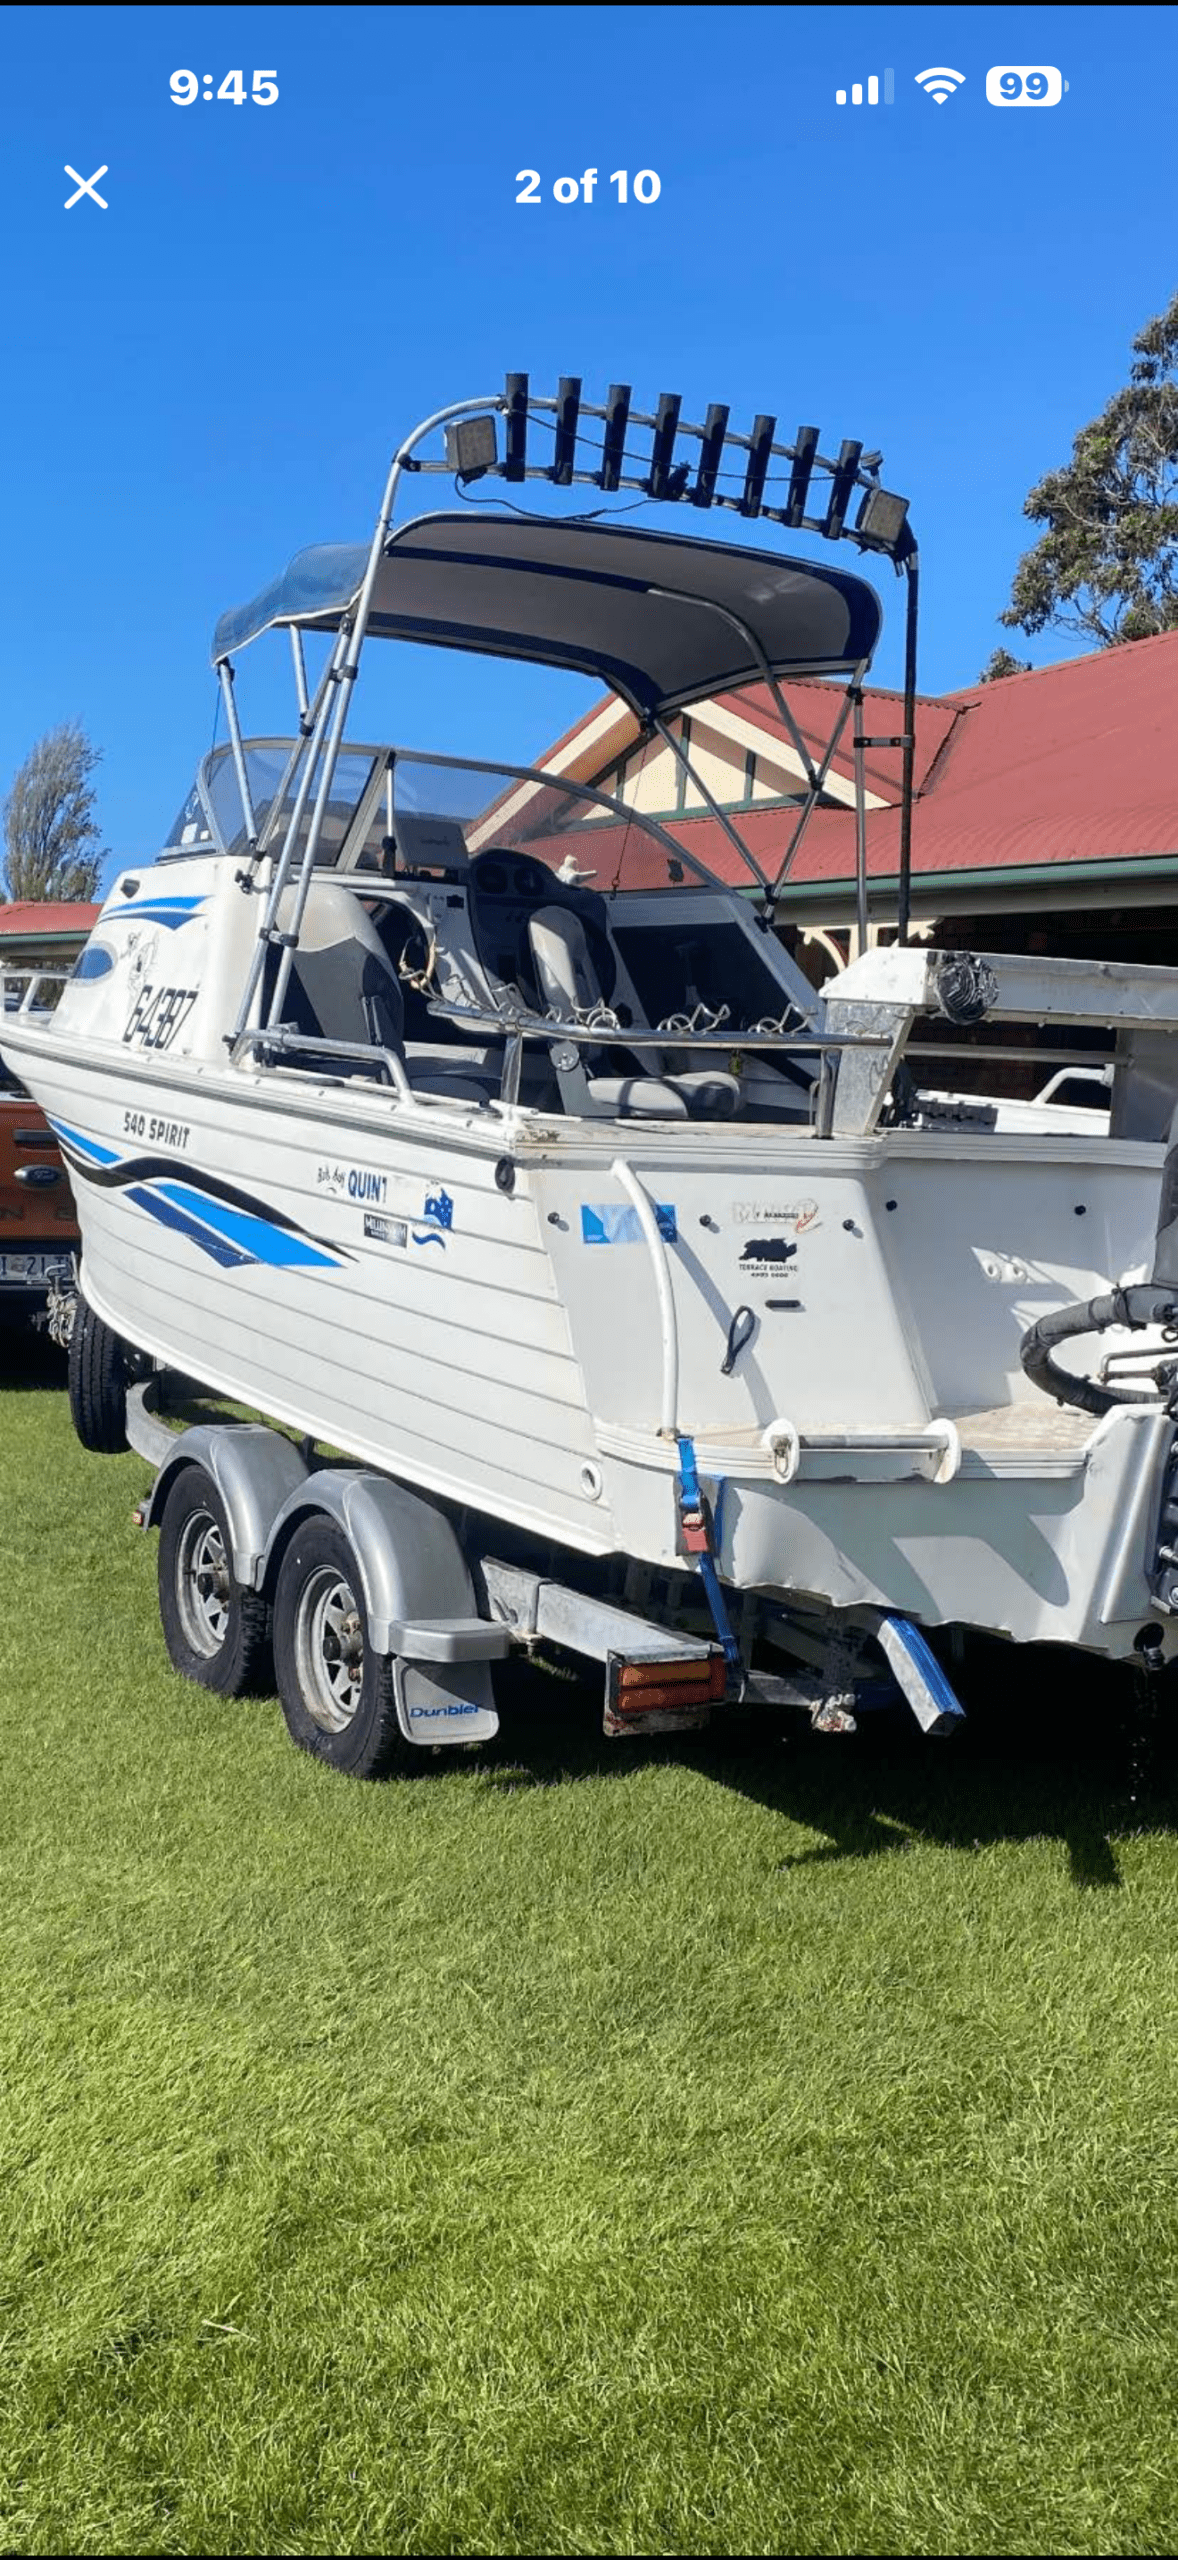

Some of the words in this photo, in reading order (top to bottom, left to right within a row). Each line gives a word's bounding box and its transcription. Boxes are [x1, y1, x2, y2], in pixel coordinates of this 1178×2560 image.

[122, 985, 199, 1051] 64387
[124, 1112, 146, 1137] 540
[149, 1118, 190, 1149] SPIRIT
